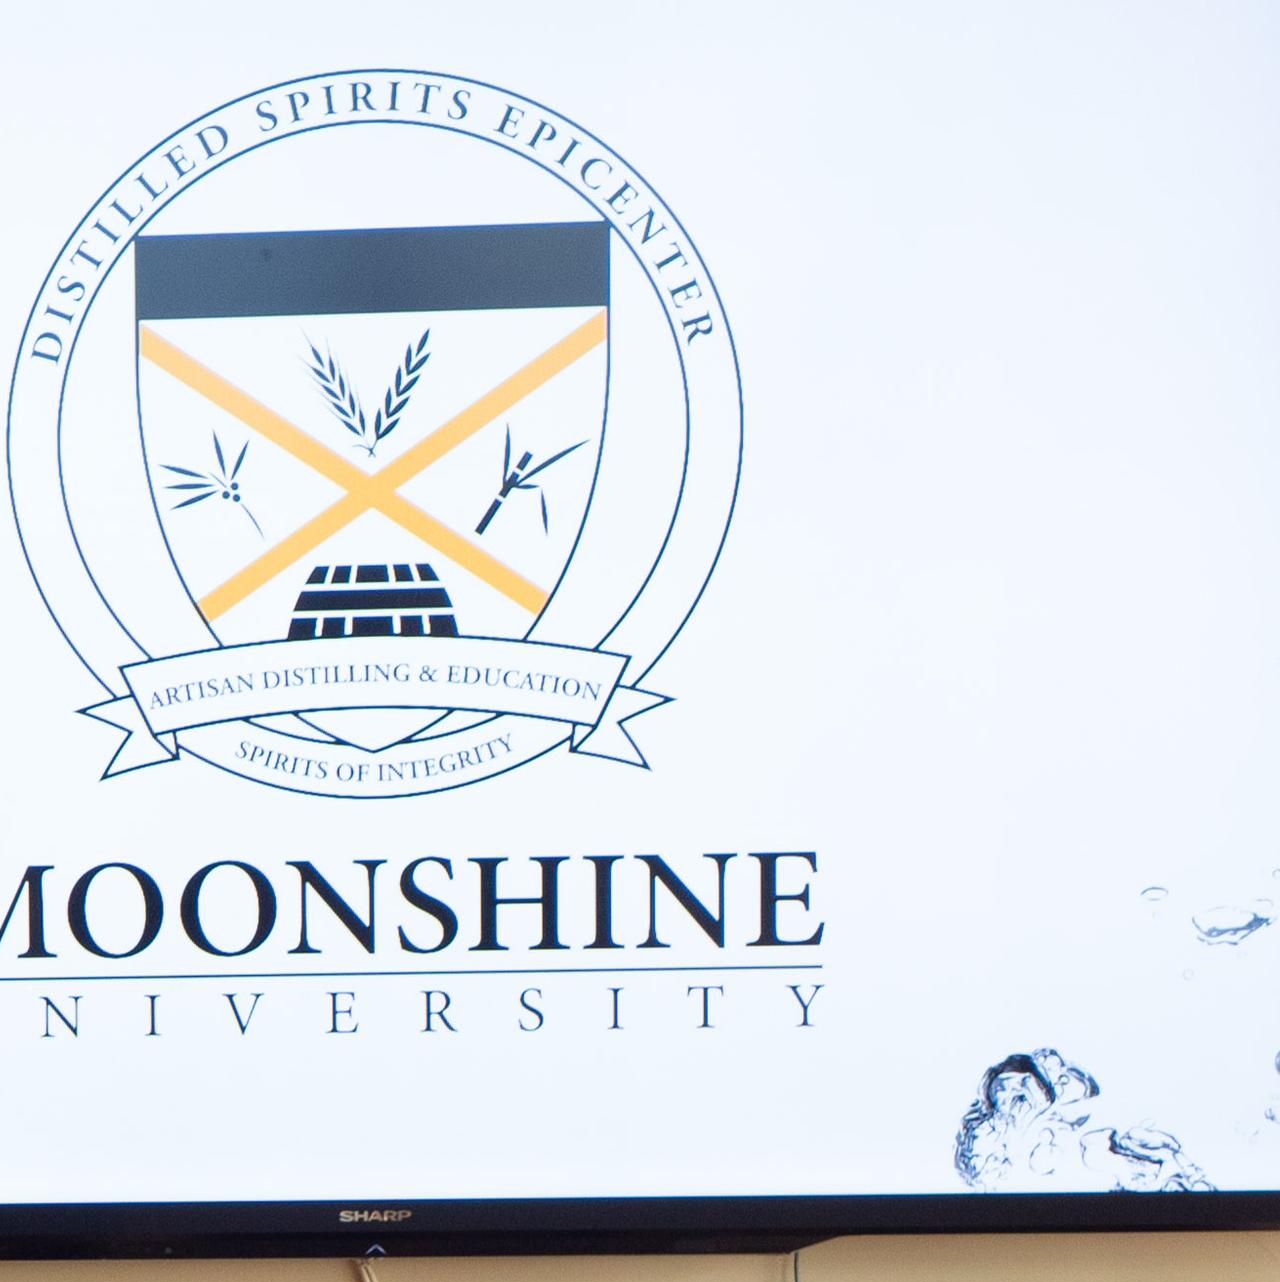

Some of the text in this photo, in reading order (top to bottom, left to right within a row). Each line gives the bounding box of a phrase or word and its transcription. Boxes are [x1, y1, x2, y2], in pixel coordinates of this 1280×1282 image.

[31, 81, 714, 364] DISTILLED SPIRITS EPICENTER
[149, 663, 603, 711] ARTISAN DISTILLING & EDUCATION
[234, 734, 515, 782] SPIRITS OF INTEGRITY
[339, 1209, 412, 1223] SHARP
